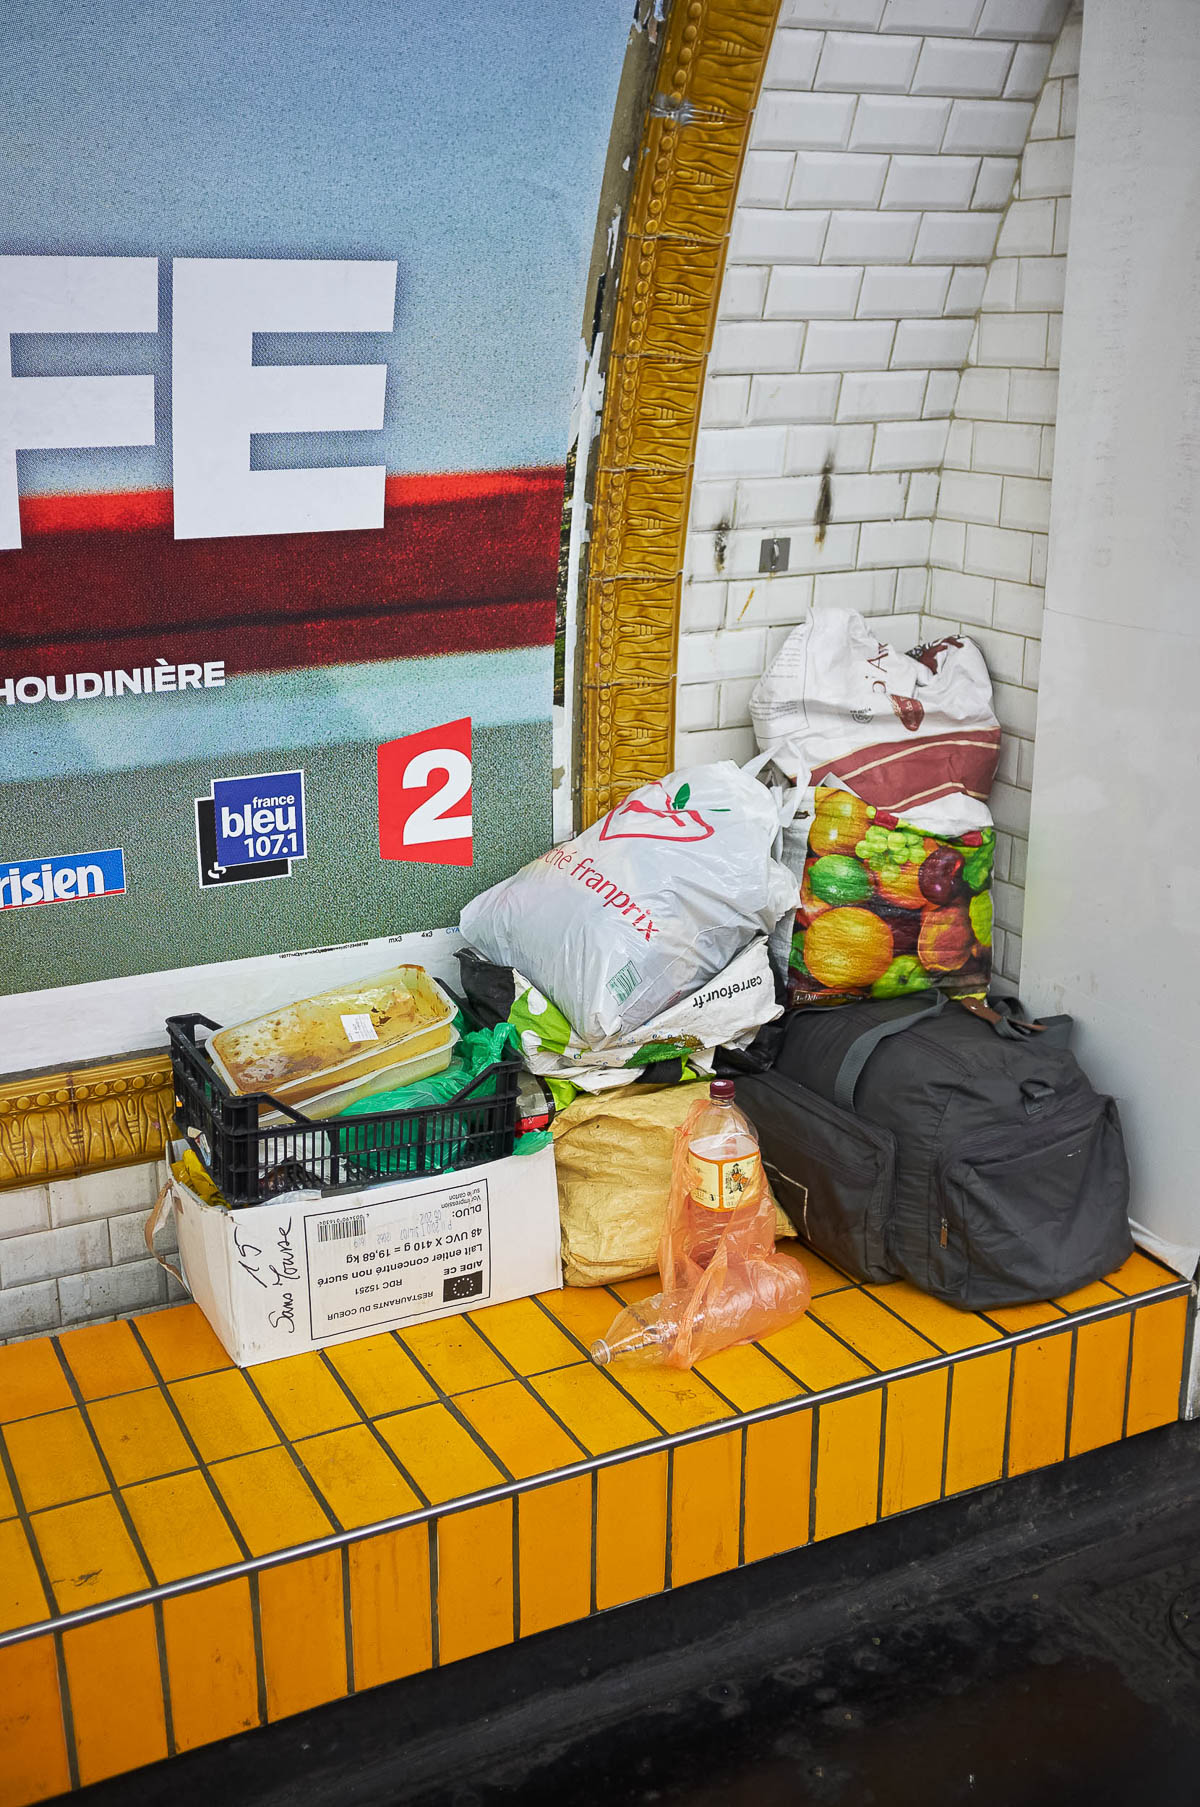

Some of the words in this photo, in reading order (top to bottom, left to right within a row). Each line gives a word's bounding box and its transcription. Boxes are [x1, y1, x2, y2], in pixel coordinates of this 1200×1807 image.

[253, 794, 295, 809] france
[402, 748, 472, 846] 2
[221, 806, 297, 839] bleu
[244, 834, 298, 858] 107.1
[570, 858, 659, 942] franprix
[693, 975, 763, 1009] carrefour.fr
[448, 1191, 466, 1201] carton
[441, 1197, 471, 1209] impression
[452, 1204, 482, 1218] DLUO:
[445, 1231, 468, 1244] UVC
[471, 1227, 483, 1238] 48
[404, 1242, 411, 1252] g
[414, 1240, 433, 1251] 410
[435, 1237, 443, 1247] X
[362, 1248, 391, 1262] 19,68
[431, 1248, 462, 1262] entier
[465, 1243, 483, 1255] Lait
[346, 1253, 360, 1264] kg
[375, 1256, 429, 1275] concentré
[443, 1266, 457, 1276] CE
[460, 1259, 483, 1272] AIDE
[317, 1273, 348, 1287] sucré
[351, 1269, 373, 1279] non
[355, 1283, 380, 1295] 15251
[383, 1278, 403, 1290] RDC
[373, 1290, 434, 1310] RESTAURANTS
[327, 1307, 357, 1321] COEUR
[359, 1304, 371, 1314] DU
